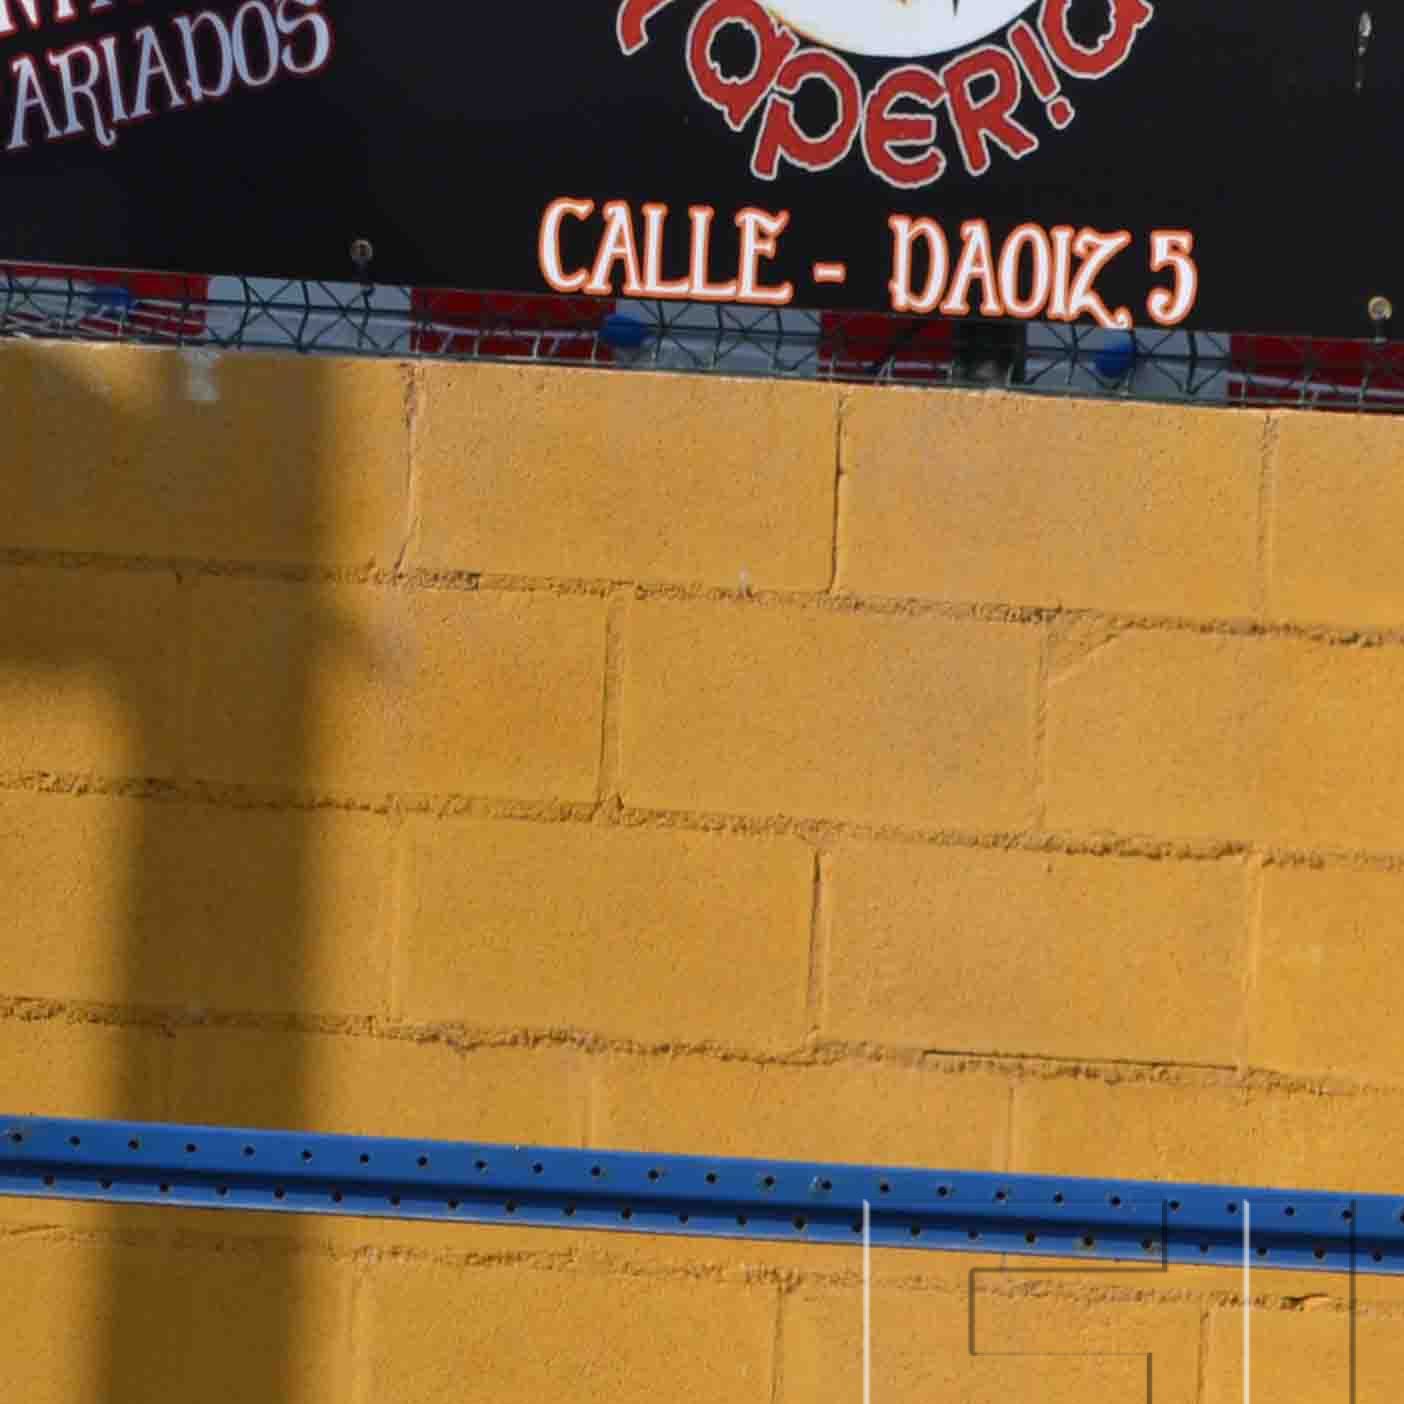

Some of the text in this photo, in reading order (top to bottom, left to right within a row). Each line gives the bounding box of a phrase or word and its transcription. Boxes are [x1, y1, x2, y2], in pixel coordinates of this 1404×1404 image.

[538, 197, 1198, 329] CALLE - DAOIZ 5
